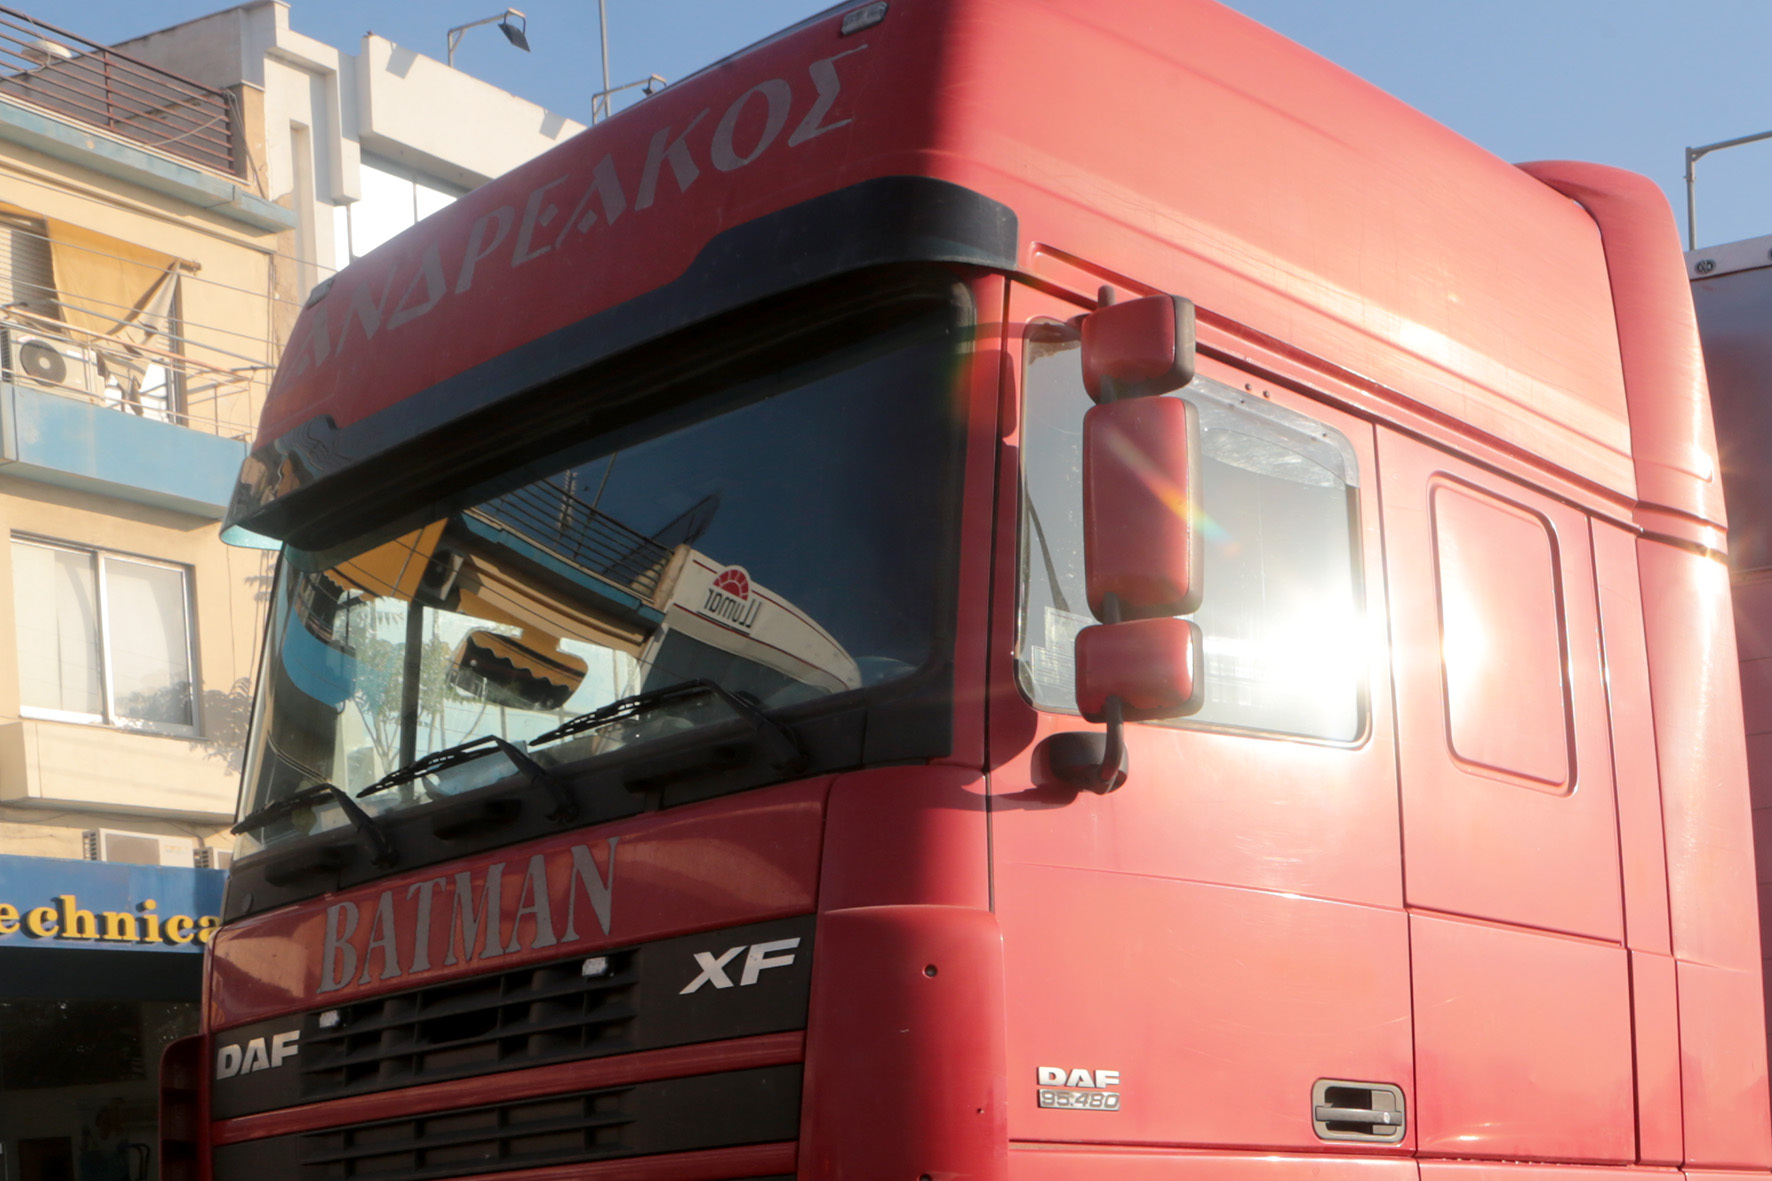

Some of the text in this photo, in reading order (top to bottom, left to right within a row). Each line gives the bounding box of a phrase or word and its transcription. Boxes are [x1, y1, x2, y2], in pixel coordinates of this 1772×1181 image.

[316, 836, 621, 995] BATMAN
[679, 937, 801, 995] XF
[217, 1029, 300, 1080] DAF
[1037, 1066, 1120, 1088] DAF
[1041, 1090, 1120, 1109] 95.480
